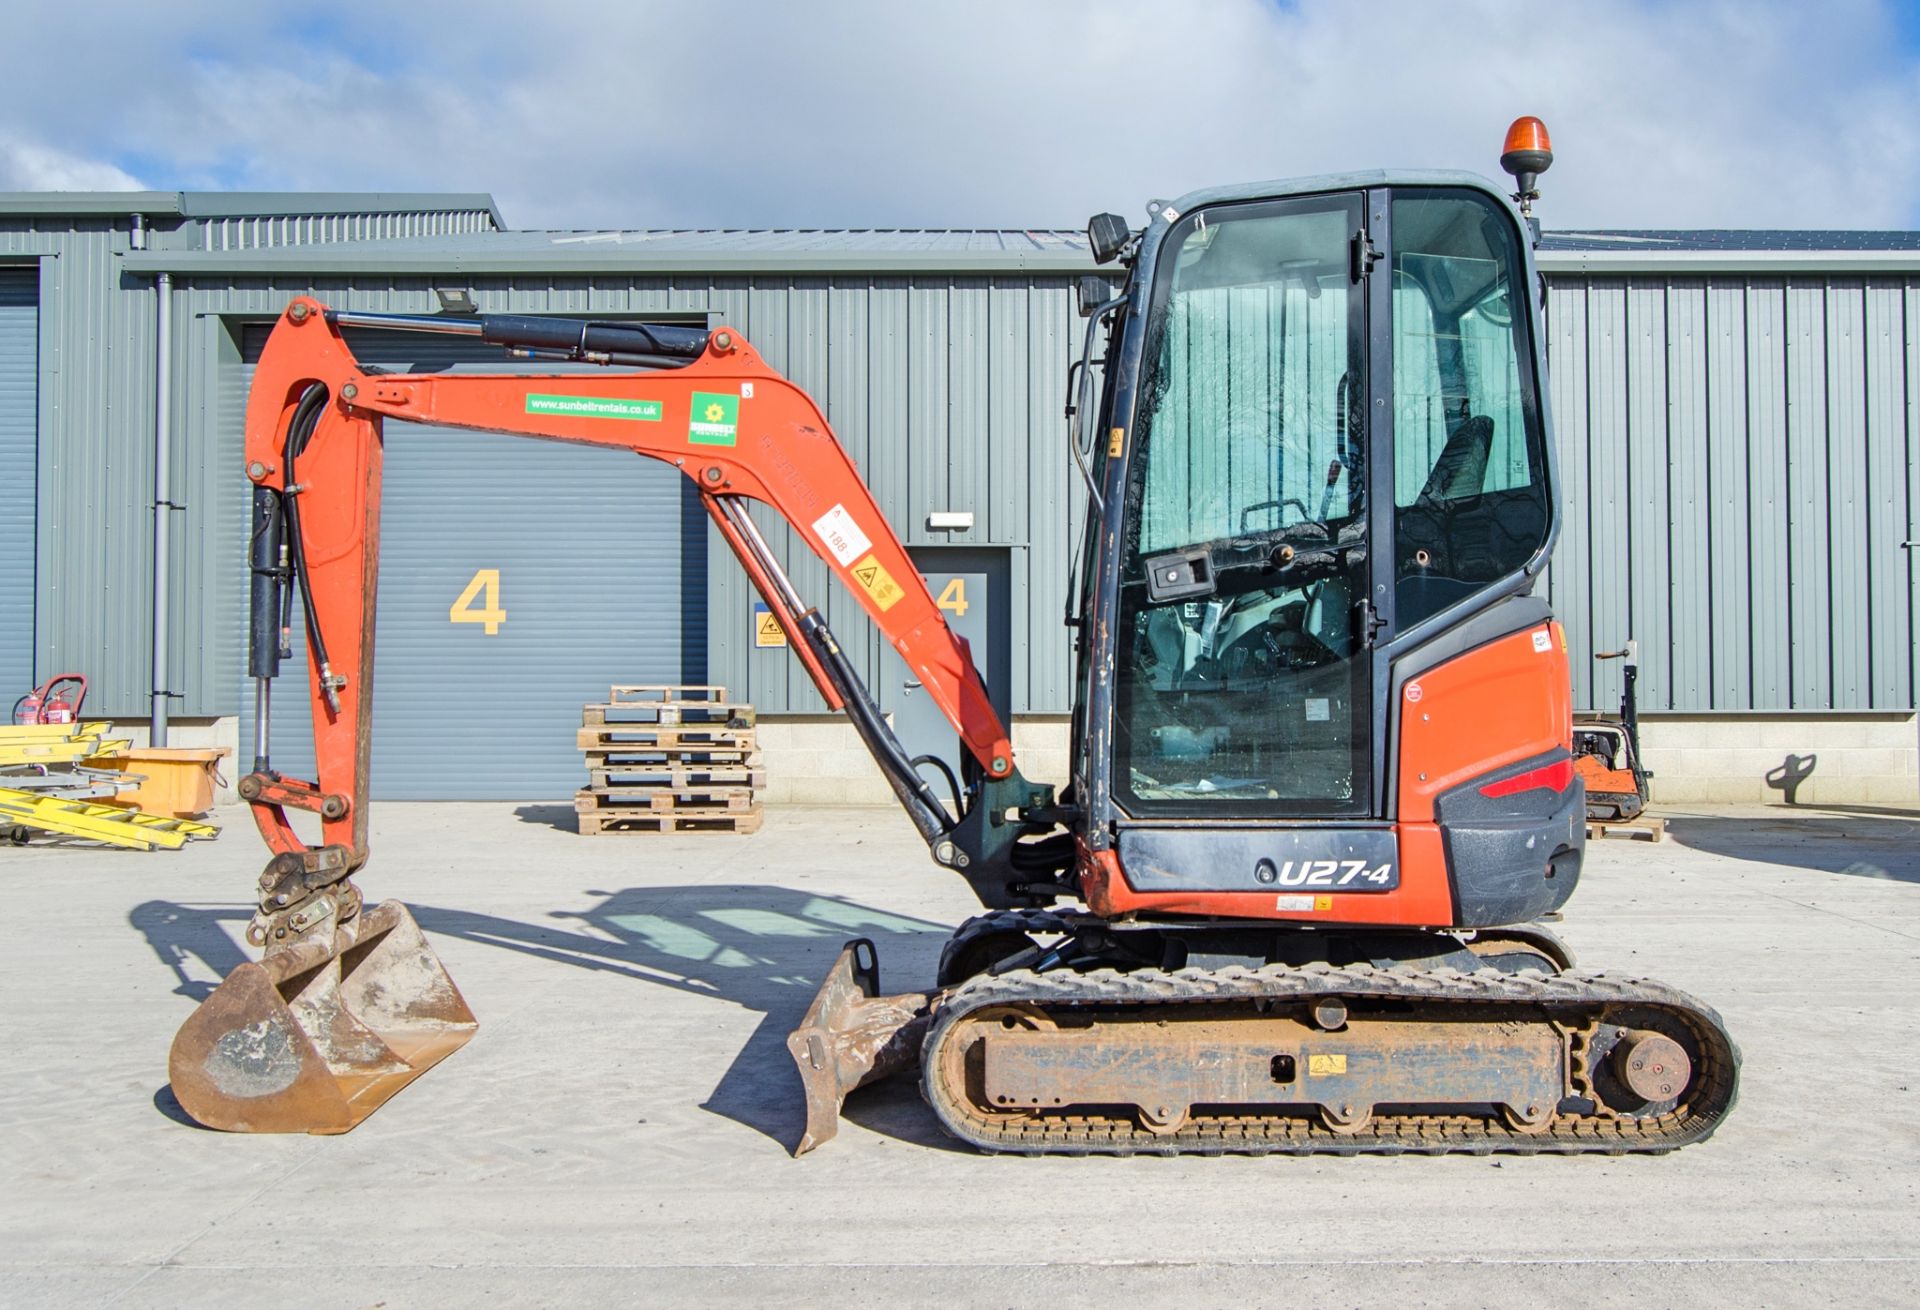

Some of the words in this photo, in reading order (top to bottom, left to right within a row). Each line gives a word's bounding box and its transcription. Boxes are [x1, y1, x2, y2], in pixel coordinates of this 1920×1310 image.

[531, 399, 657, 416] www.sunbeltrentals.co.uk
[829, 530, 848, 552] 188
[450, 568, 507, 635] 4
[936, 578, 969, 616] 4
[1278, 860, 1392, 886] U27-4
